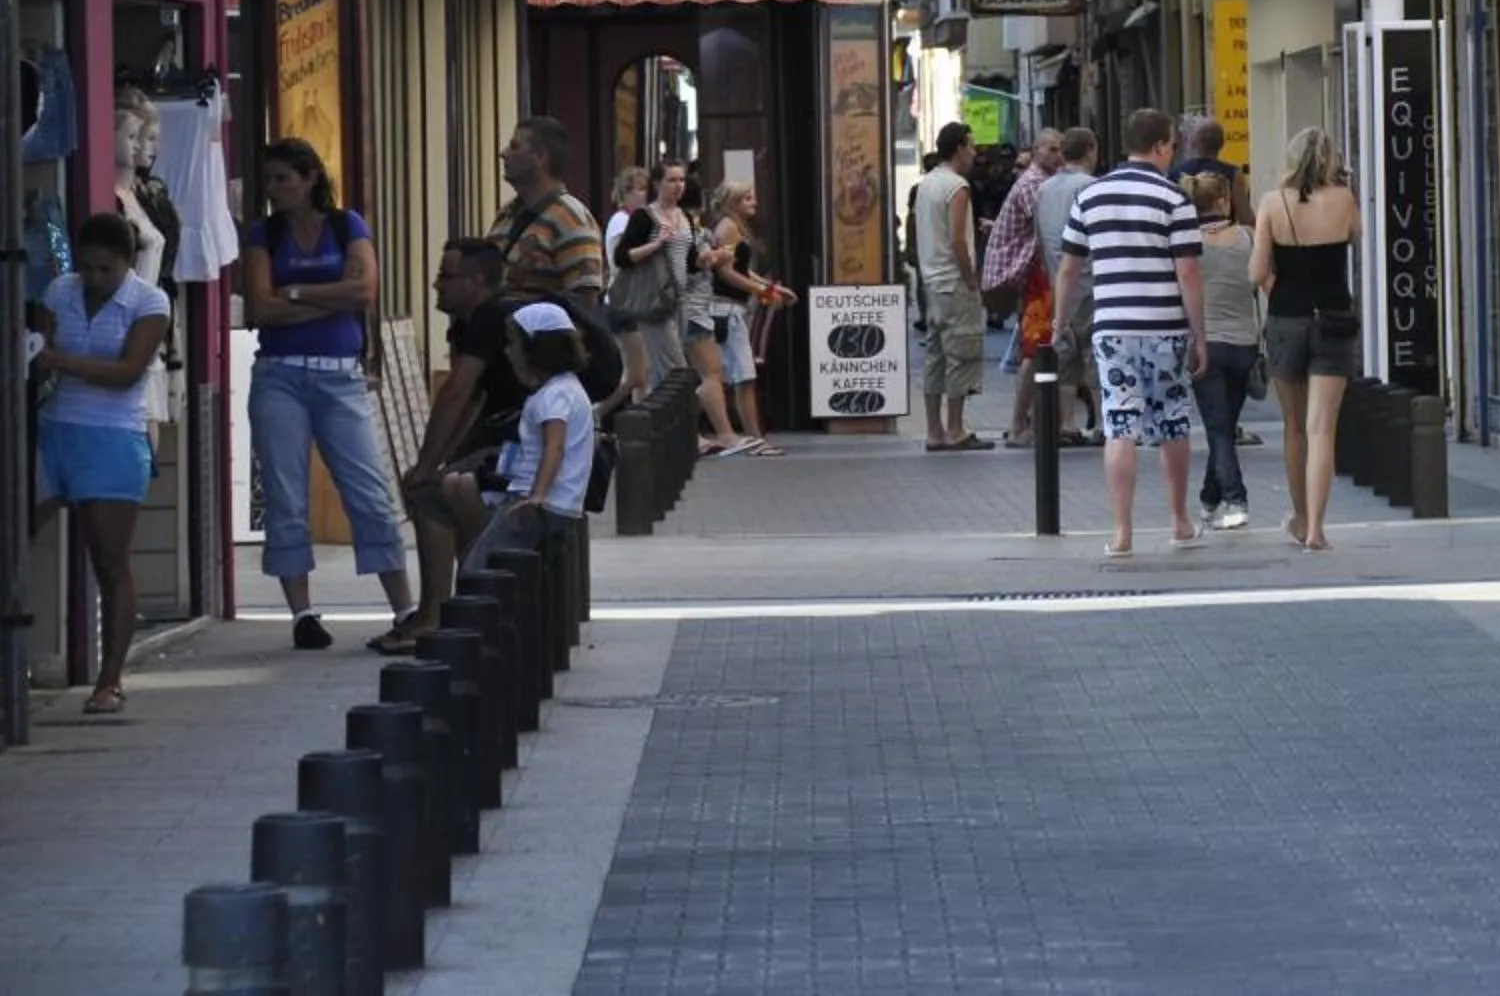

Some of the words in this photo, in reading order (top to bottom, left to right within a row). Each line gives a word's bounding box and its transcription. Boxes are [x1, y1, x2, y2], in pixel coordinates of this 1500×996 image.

[1391, 67, 1416, 366] EQUIVOQUE
[815, 294, 899, 308] DEUTSCHER
[832, 311, 885, 324] KAFFEE
[833, 377, 885, 389] KAFFEE
